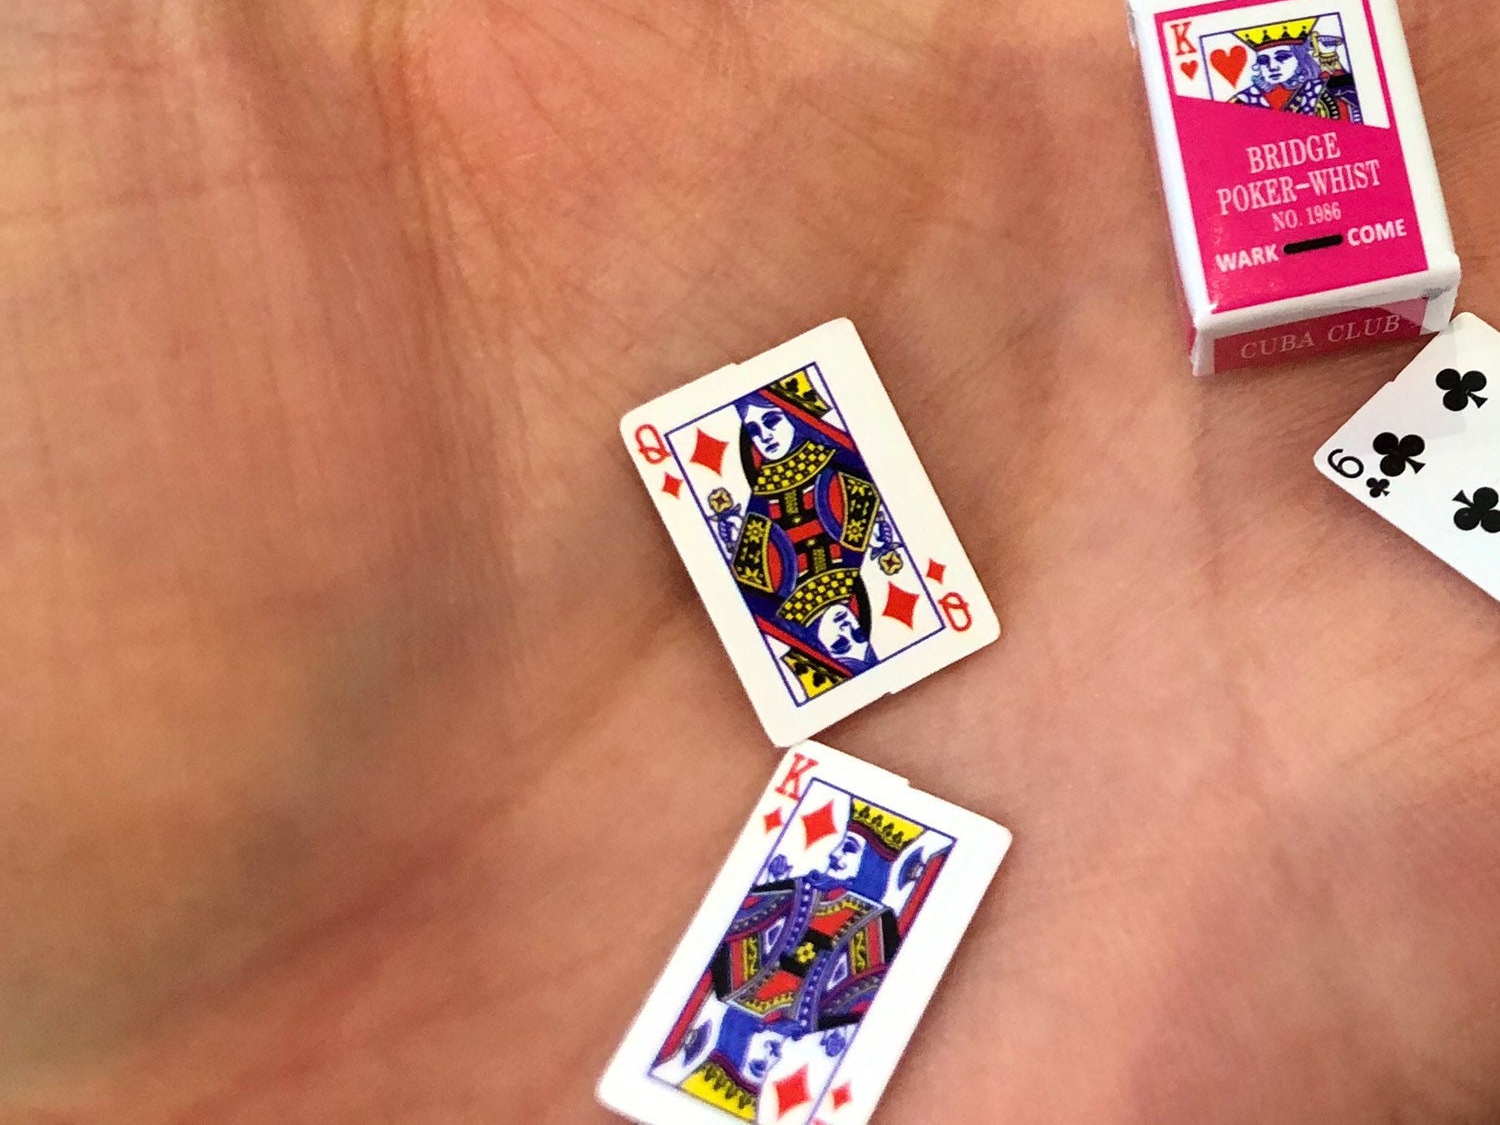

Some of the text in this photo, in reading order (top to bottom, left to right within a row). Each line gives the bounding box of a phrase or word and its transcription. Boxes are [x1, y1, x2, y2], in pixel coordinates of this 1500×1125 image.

[1171, 21, 1197, 56] K
[1246, 132, 1340, 174] BRIDGE
[1217, 159, 1381, 216] POKER-WHIST
[1271, 202, 1342, 232] NO. 1986
[1215, 219, 1407, 273] WARK COME
[1240, 313, 1400, 360] CUBA CLUB
[635, 423, 671, 464] Q
[1327, 448, 1364, 478] 6
[939, 592, 973, 633] Q
[774, 753, 818, 801] K
